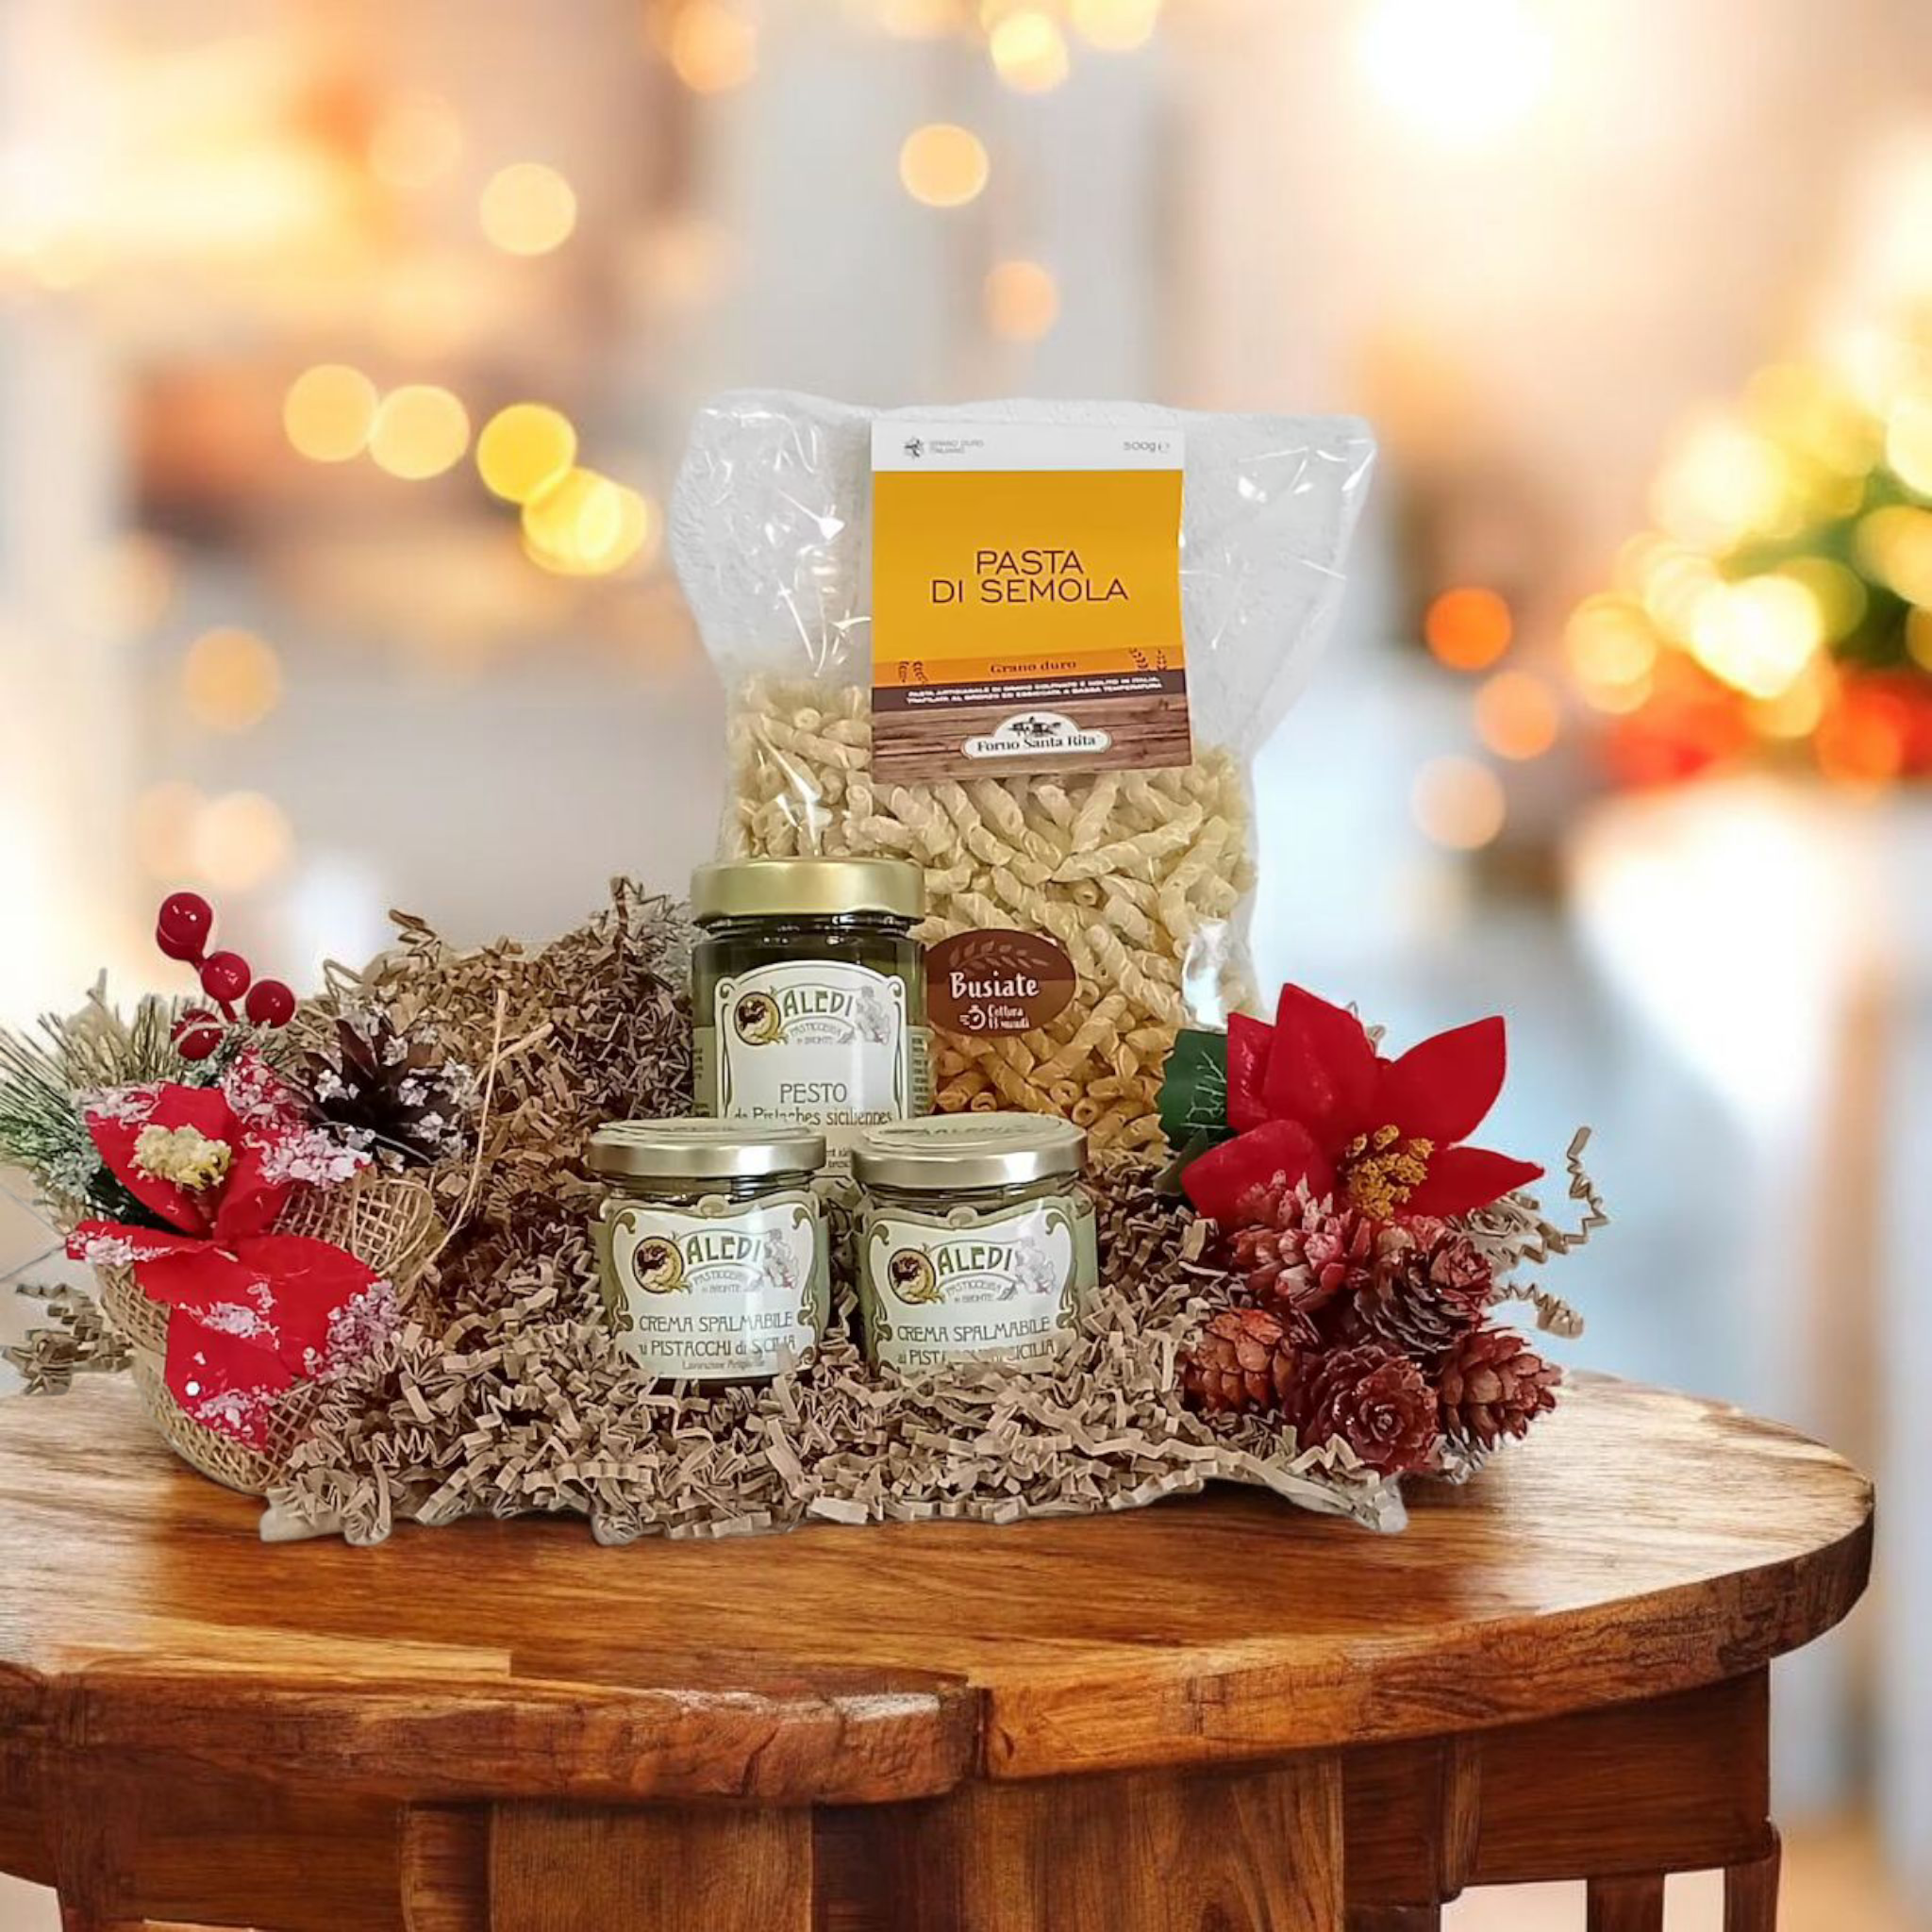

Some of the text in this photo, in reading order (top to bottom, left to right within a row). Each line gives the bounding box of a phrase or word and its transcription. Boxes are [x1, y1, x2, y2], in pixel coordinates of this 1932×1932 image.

[976, 550, 1084, 575] PASTA
[932, 578, 1129, 603] DI SEMOLA
[991, 659, 1076, 675] Grano duro
[977, 734, 1097, 753] Forno Santa Rita
[949, 970, 1040, 999] Busiate
[783, 990, 852, 1017] ALEDI
[780, 1083, 847, 1104] PESTO
[826, 1108, 893, 1125] siciliennes
[686, 1236, 761, 1265] ALEDI
[937, 1246, 1012, 1275] ALEDI
[639, 1311, 793, 1332] CREMA SPALMABILE
[897, 1316, 1051, 1342] CREMA SPALMABILE
[651, 1340, 731, 1357] PISTACCHI
[735, 1339, 747, 1355] di
